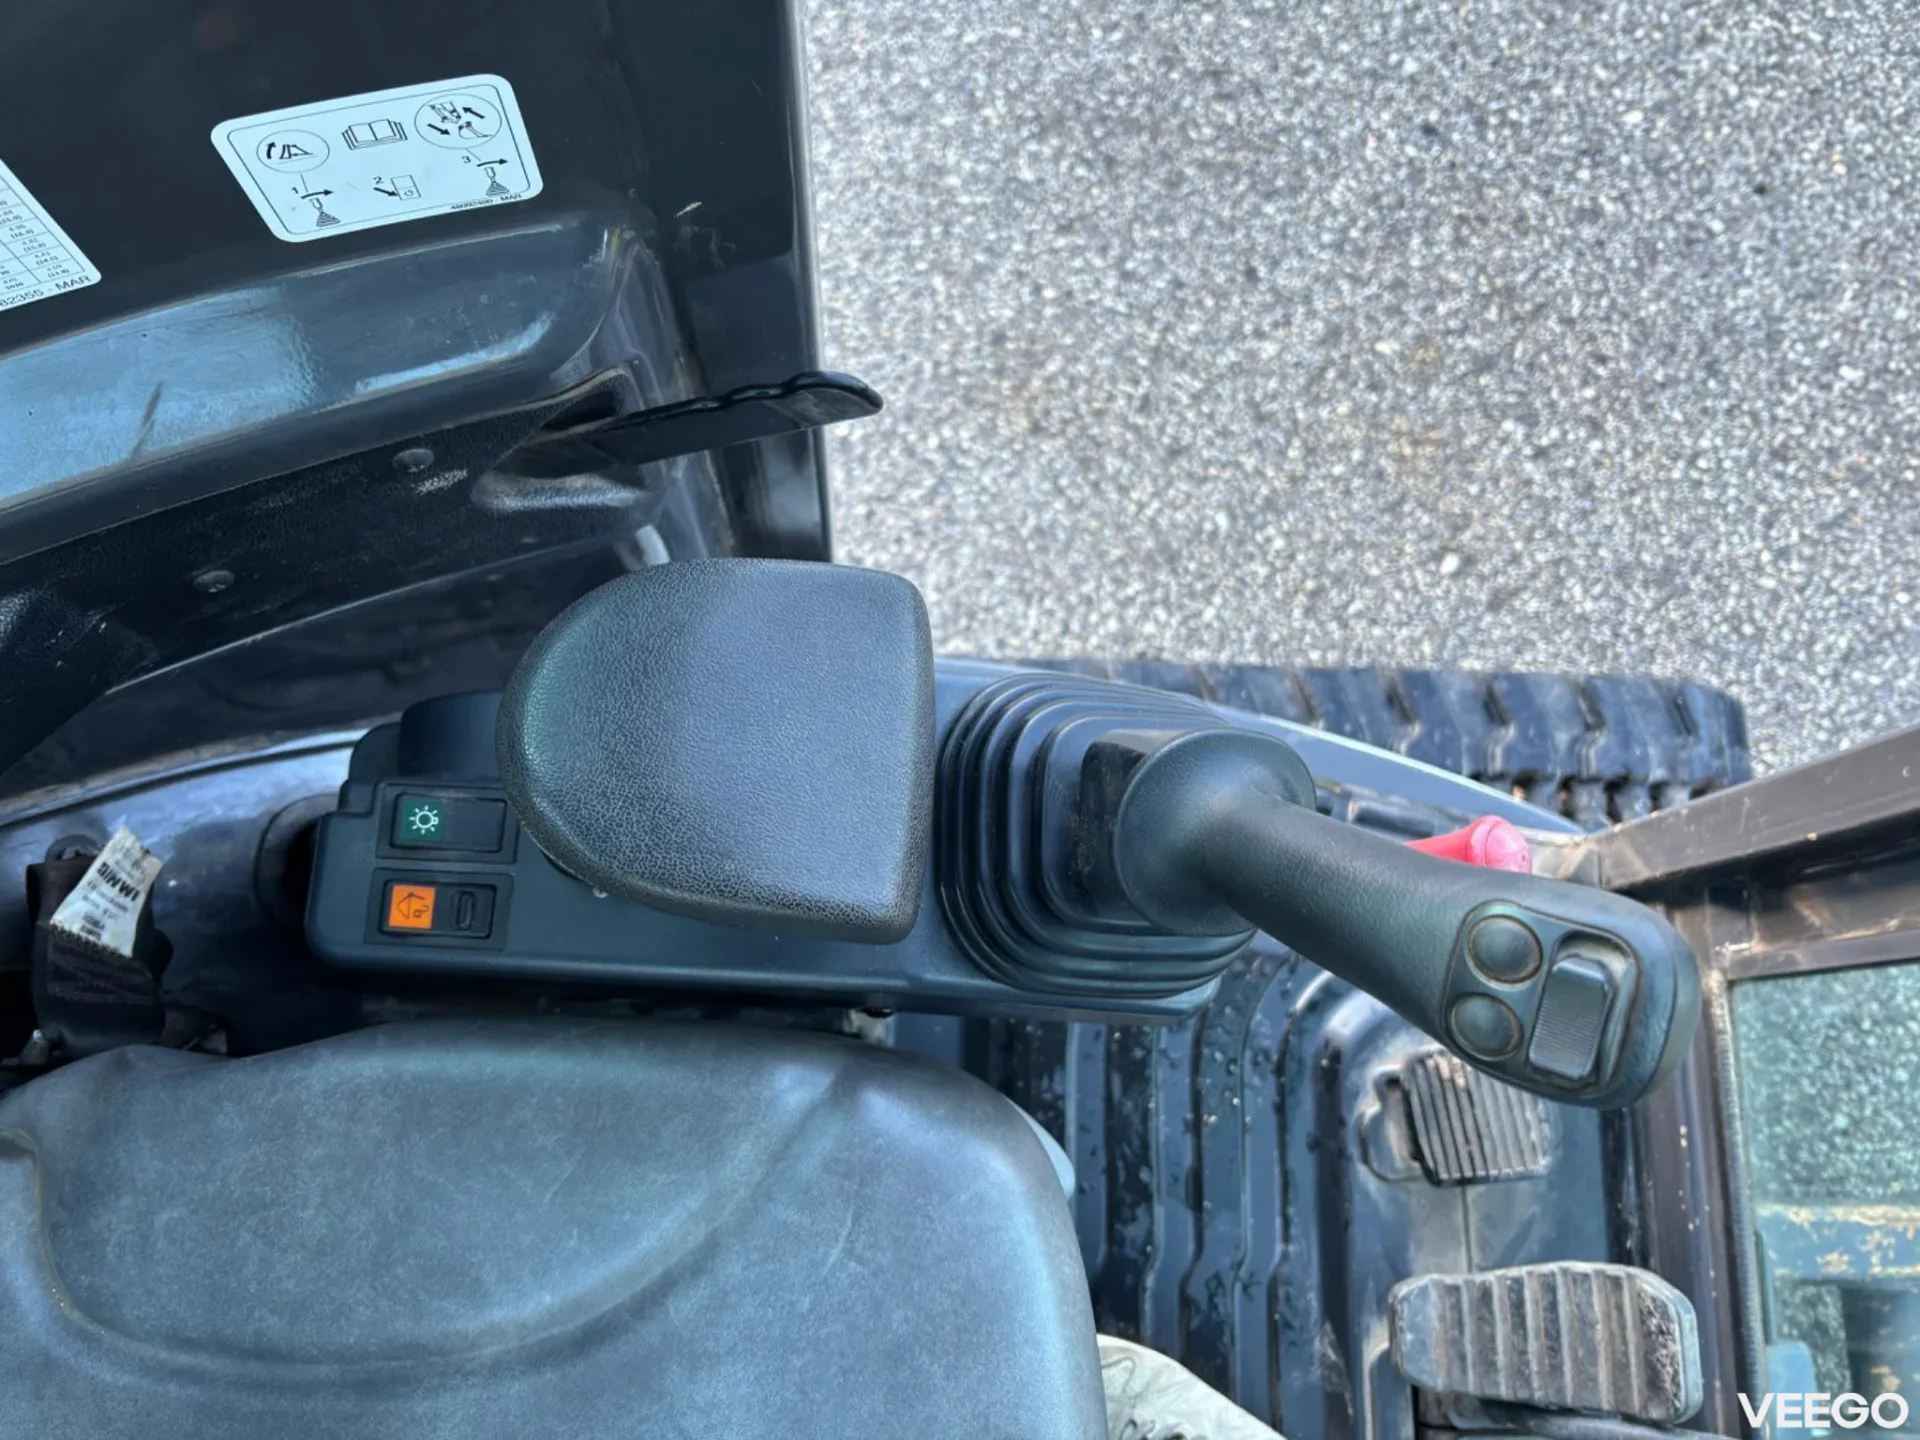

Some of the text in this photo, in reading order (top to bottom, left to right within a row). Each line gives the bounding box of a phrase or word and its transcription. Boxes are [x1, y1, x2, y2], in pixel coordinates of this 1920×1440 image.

[461, 155, 472, 164] 3
[373, 175, 384, 185] 2
[291, 186, 299, 195] 1
[55, 275, 91, 291] MAR
